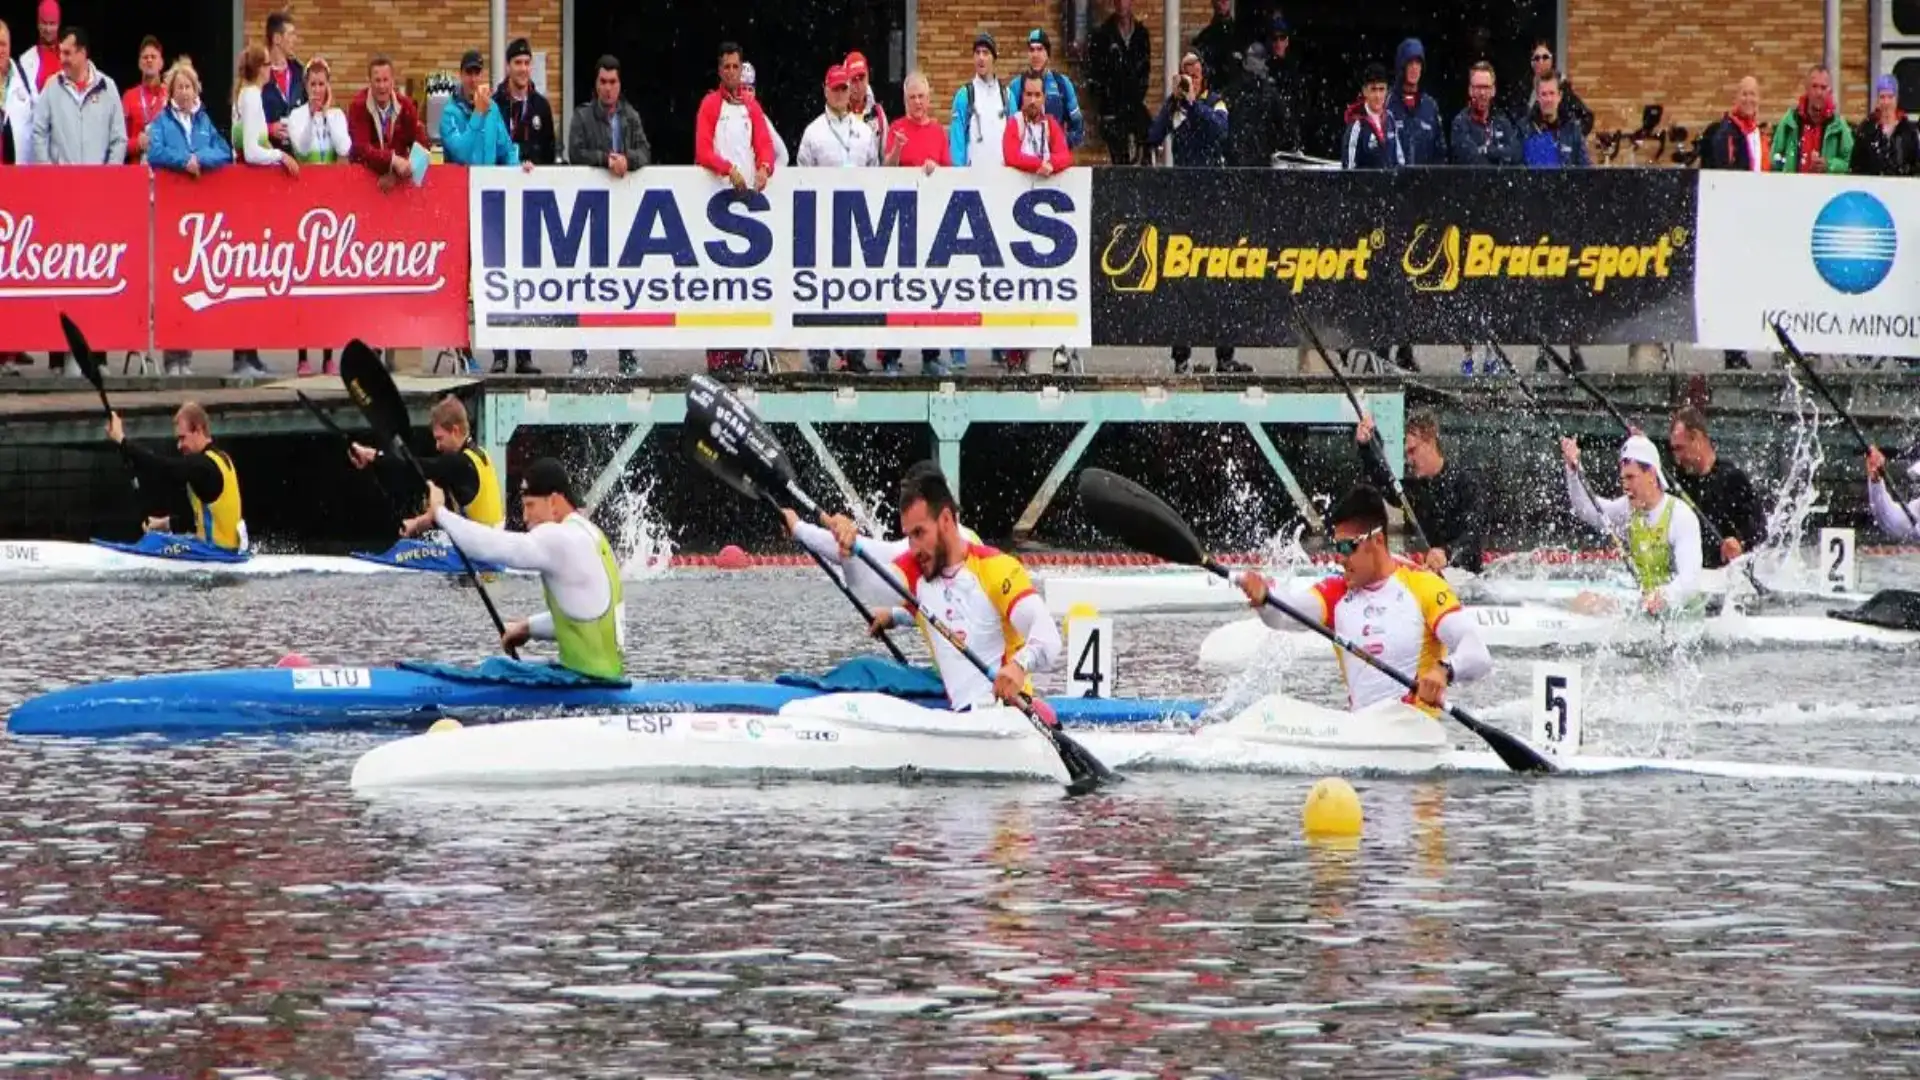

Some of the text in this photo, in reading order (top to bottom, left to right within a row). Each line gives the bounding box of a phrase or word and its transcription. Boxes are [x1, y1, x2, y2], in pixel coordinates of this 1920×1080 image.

[293, 208, 446, 282] Pilsener
[481, 188, 774, 269] IMAS
[792, 188, 1079, 269] IMAS
[485, 271, 773, 310] Sportsystems
[793, 271, 1078, 310] Sportsystems
[1762, 310, 1920, 338] KONICA MINOL
[5, 545, 39, 562] SWE
[1828, 537, 1845, 581] 2
[319, 670, 359, 687] LTU
[1073, 628, 1104, 698] 4
[626, 714, 673, 734] ESP
[1544, 675, 1567, 741] 5
